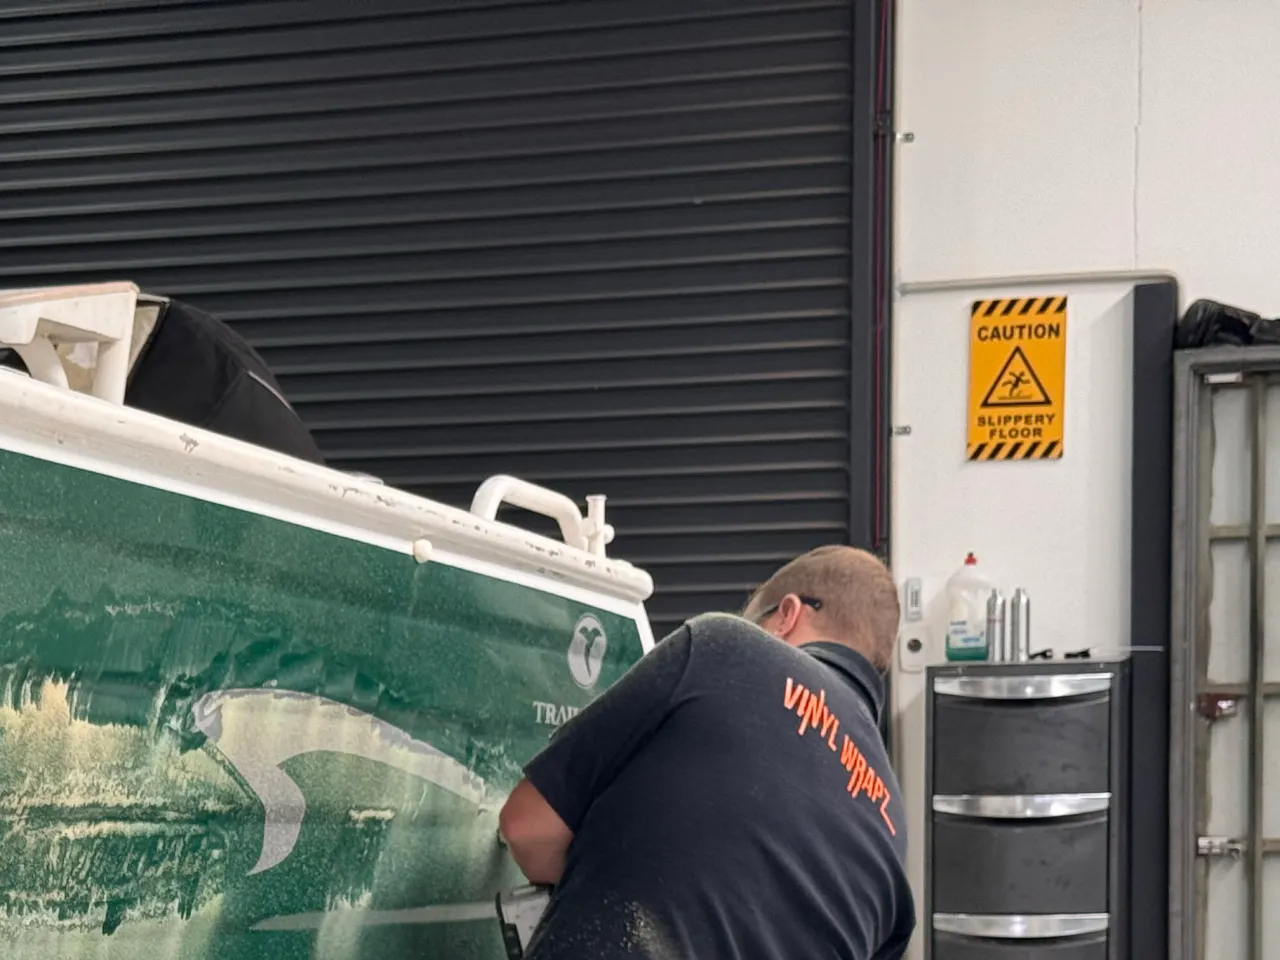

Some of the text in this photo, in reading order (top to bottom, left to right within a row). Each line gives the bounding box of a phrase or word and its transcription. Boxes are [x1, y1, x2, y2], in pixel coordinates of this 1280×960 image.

[977, 324, 1061, 342] CAUTION
[977, 413, 1057, 427] SLIPPERY
[989, 427, 1043, 440] FLOOR
[783, 677, 896, 837] VINYL WRAPZ
